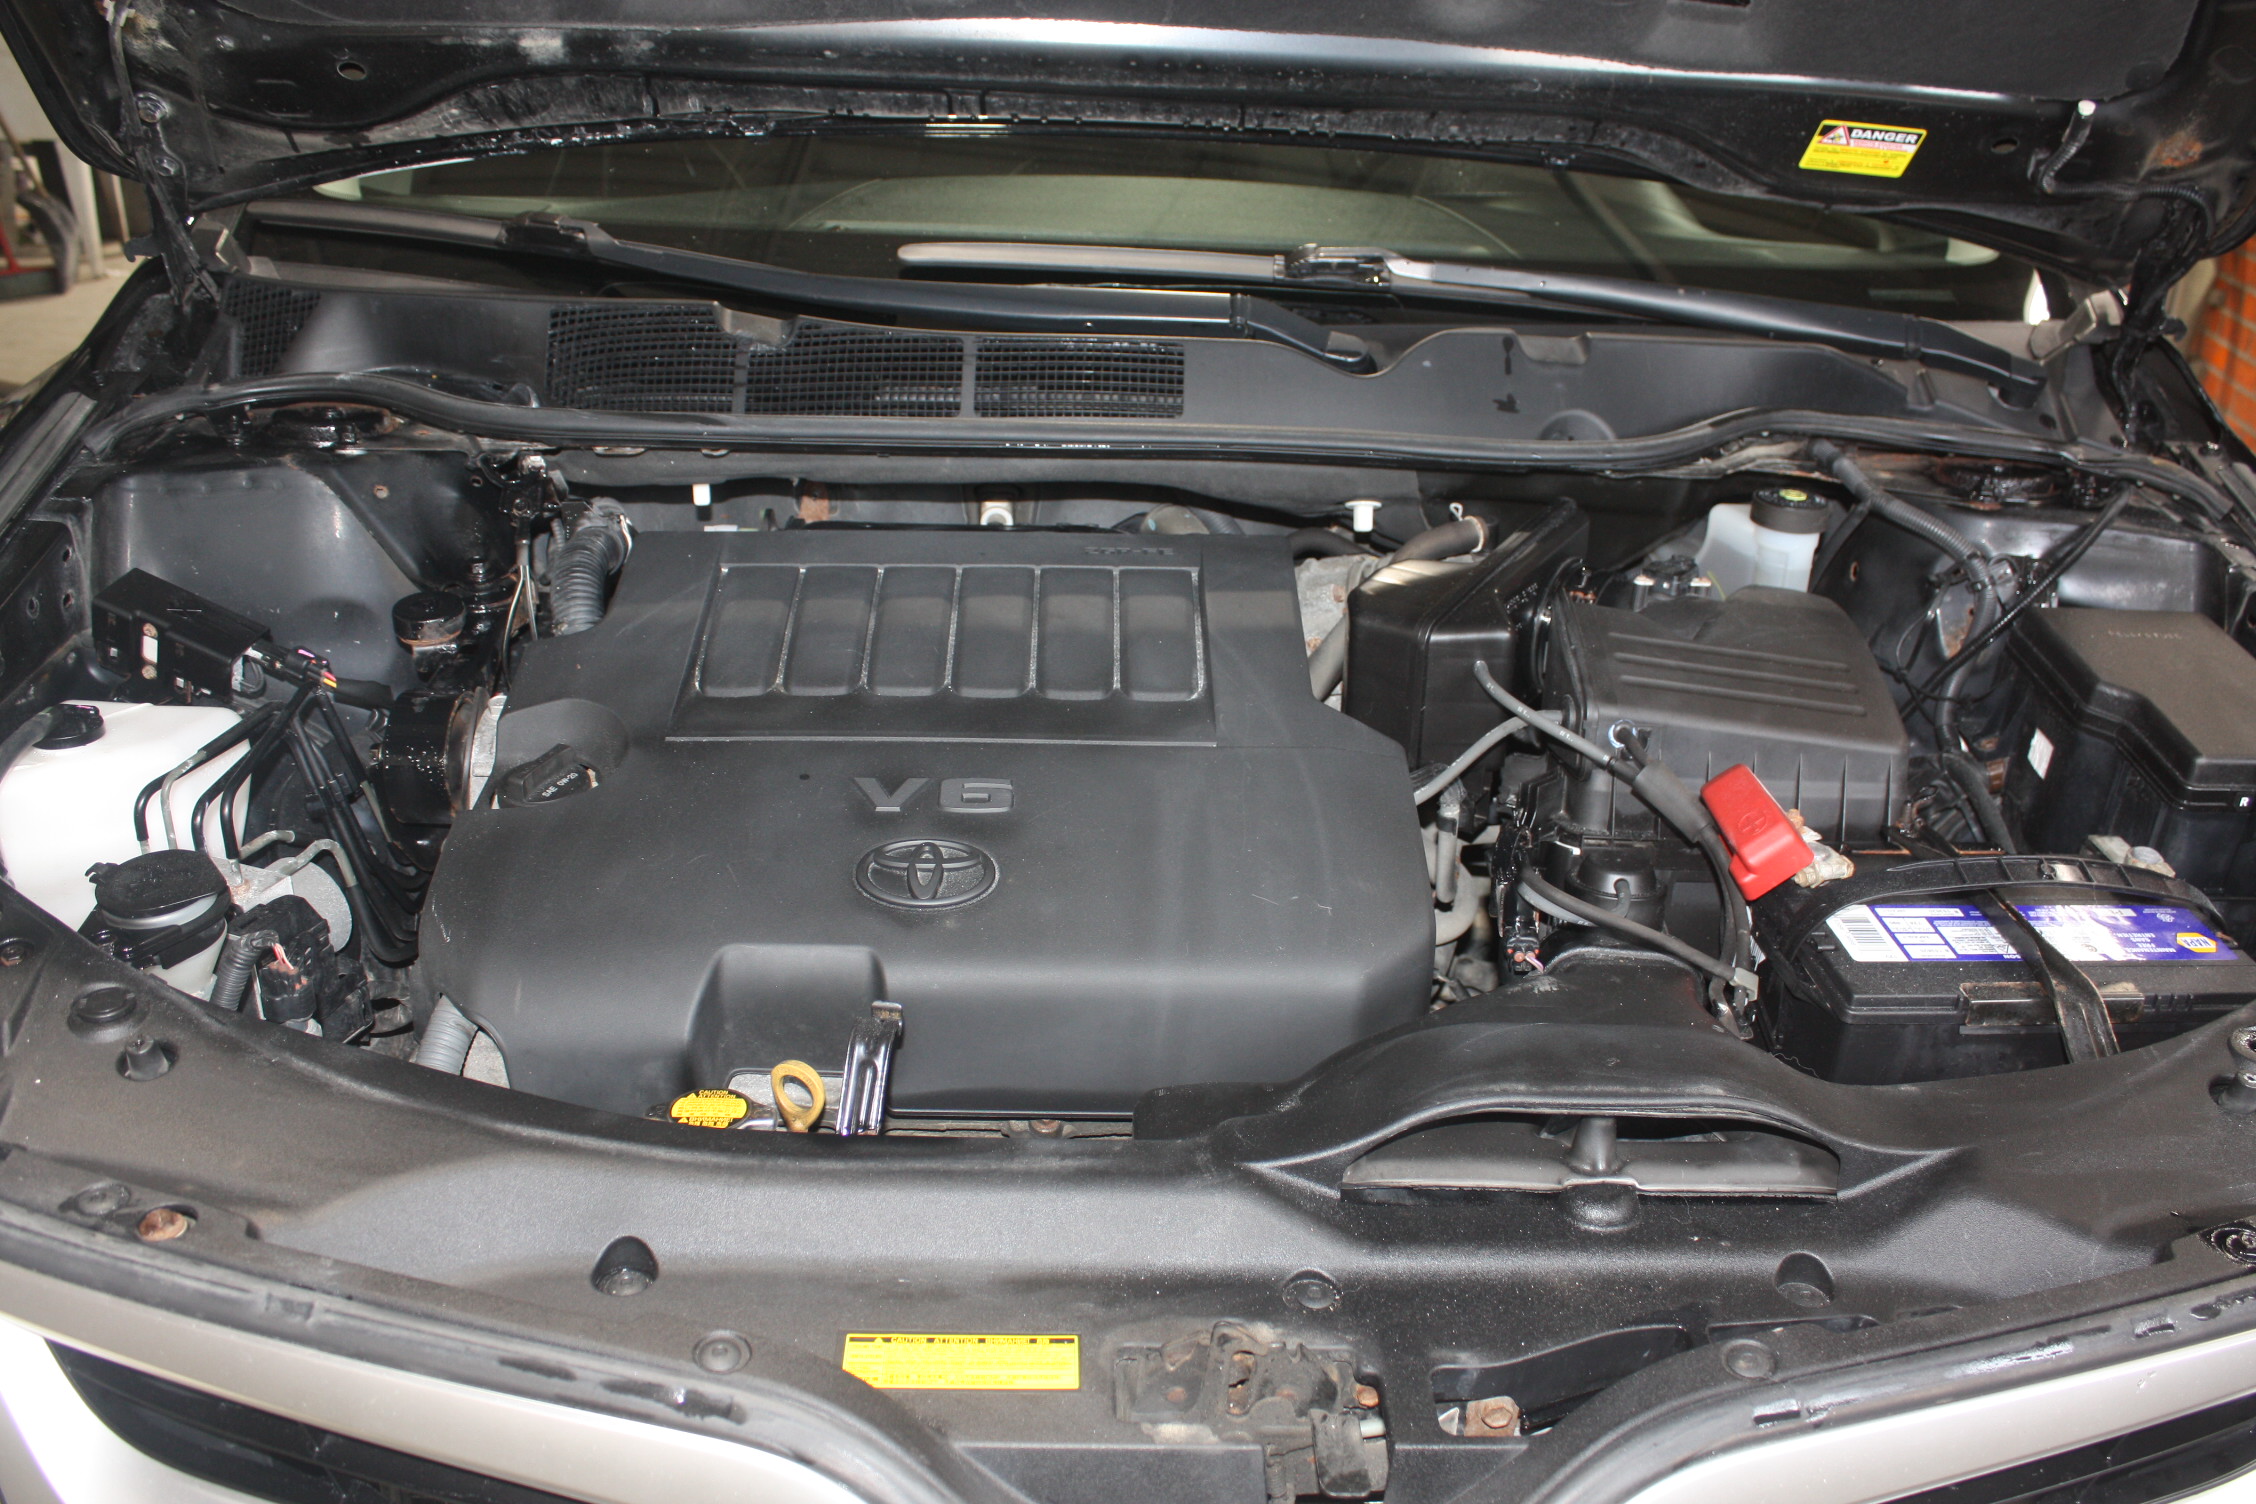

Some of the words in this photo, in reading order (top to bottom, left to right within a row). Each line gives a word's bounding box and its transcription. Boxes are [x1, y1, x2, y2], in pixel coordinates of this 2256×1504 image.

[1850, 128, 1918, 144] DANGER
[542, 786, 558, 797] SAE
[557, 772, 579, 786] 0W-20
[852, 776, 1014, 813] V6
[2239, 796, 2249, 807] R
[2182, 936, 2211, 947] NAPA
[933, 1337, 978, 1345] ATTENTION
